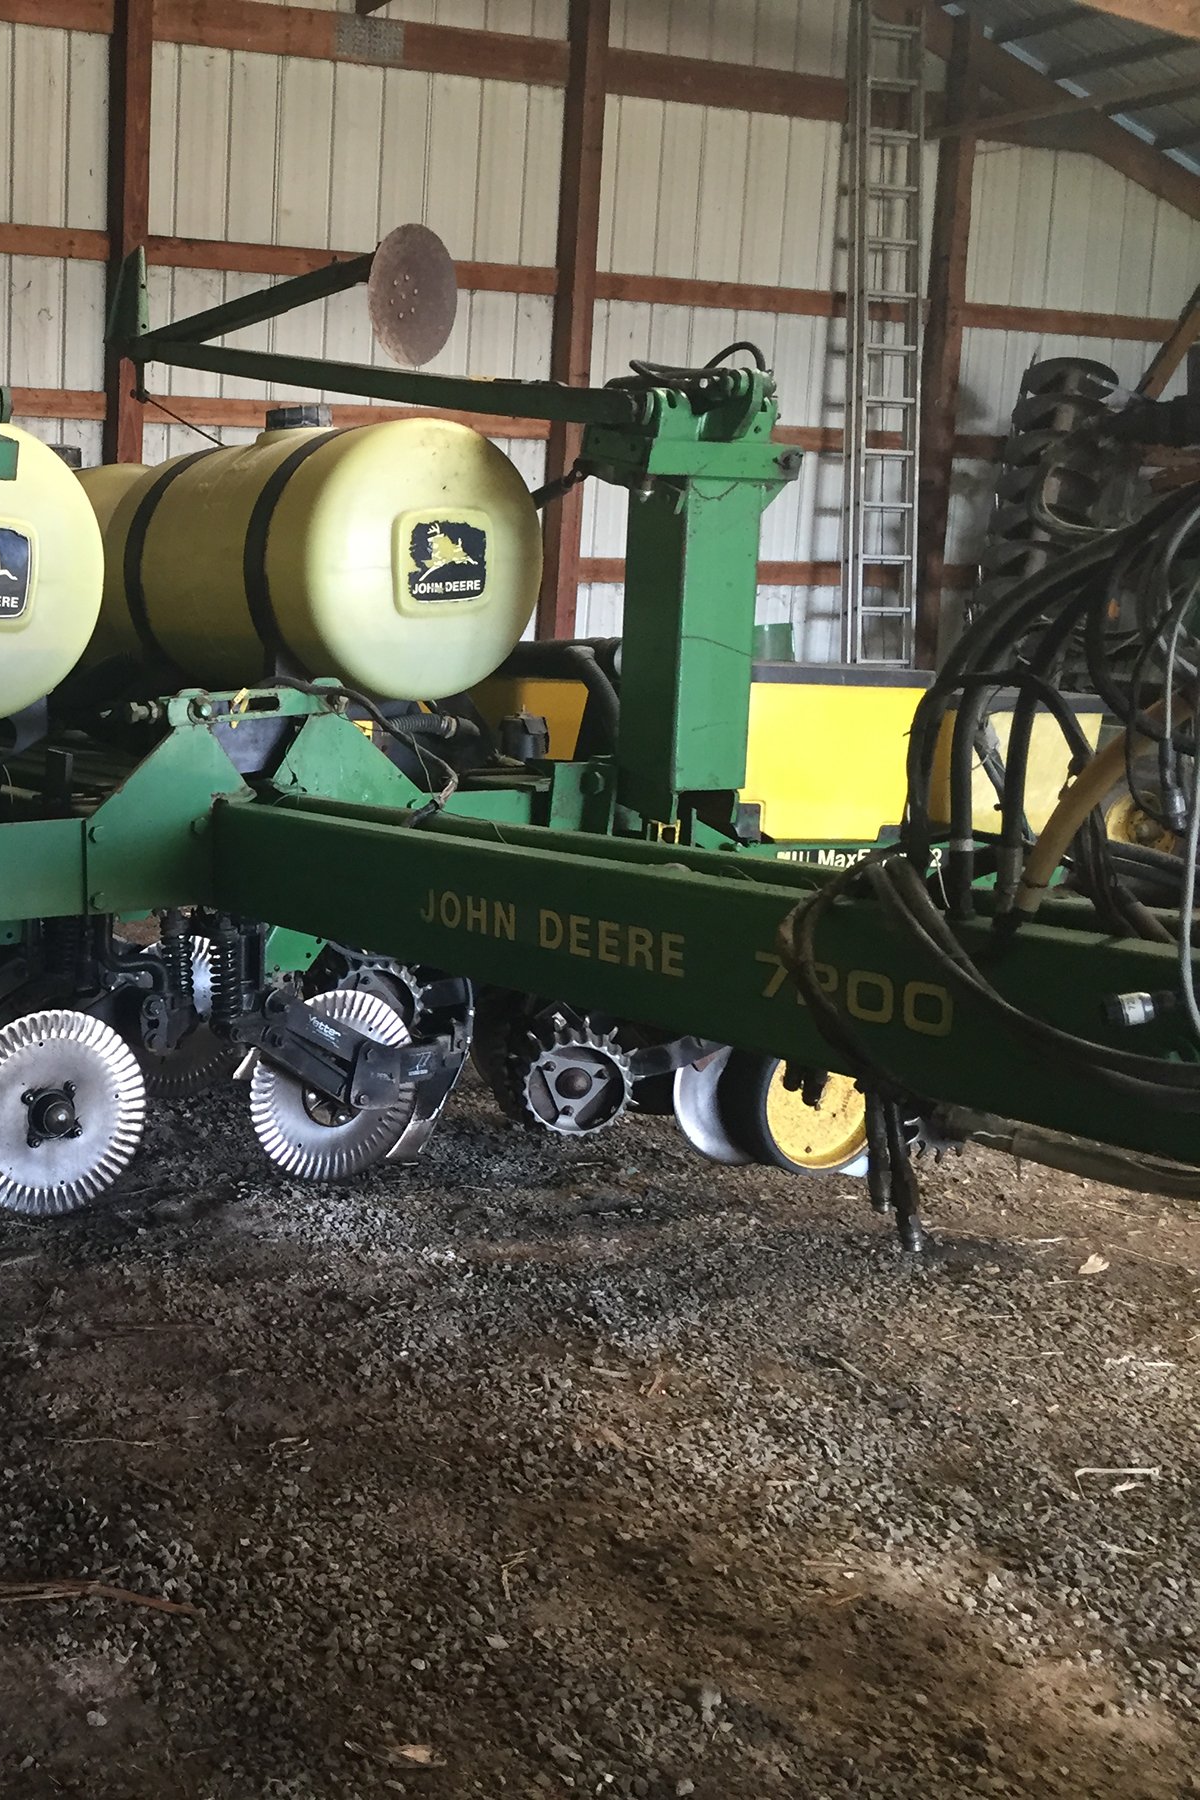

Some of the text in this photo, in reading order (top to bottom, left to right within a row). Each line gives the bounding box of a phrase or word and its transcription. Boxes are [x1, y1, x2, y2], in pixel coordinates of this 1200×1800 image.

[445, 579, 481, 592] DEERE
[420, 889, 686, 978] JOHN DEERE
